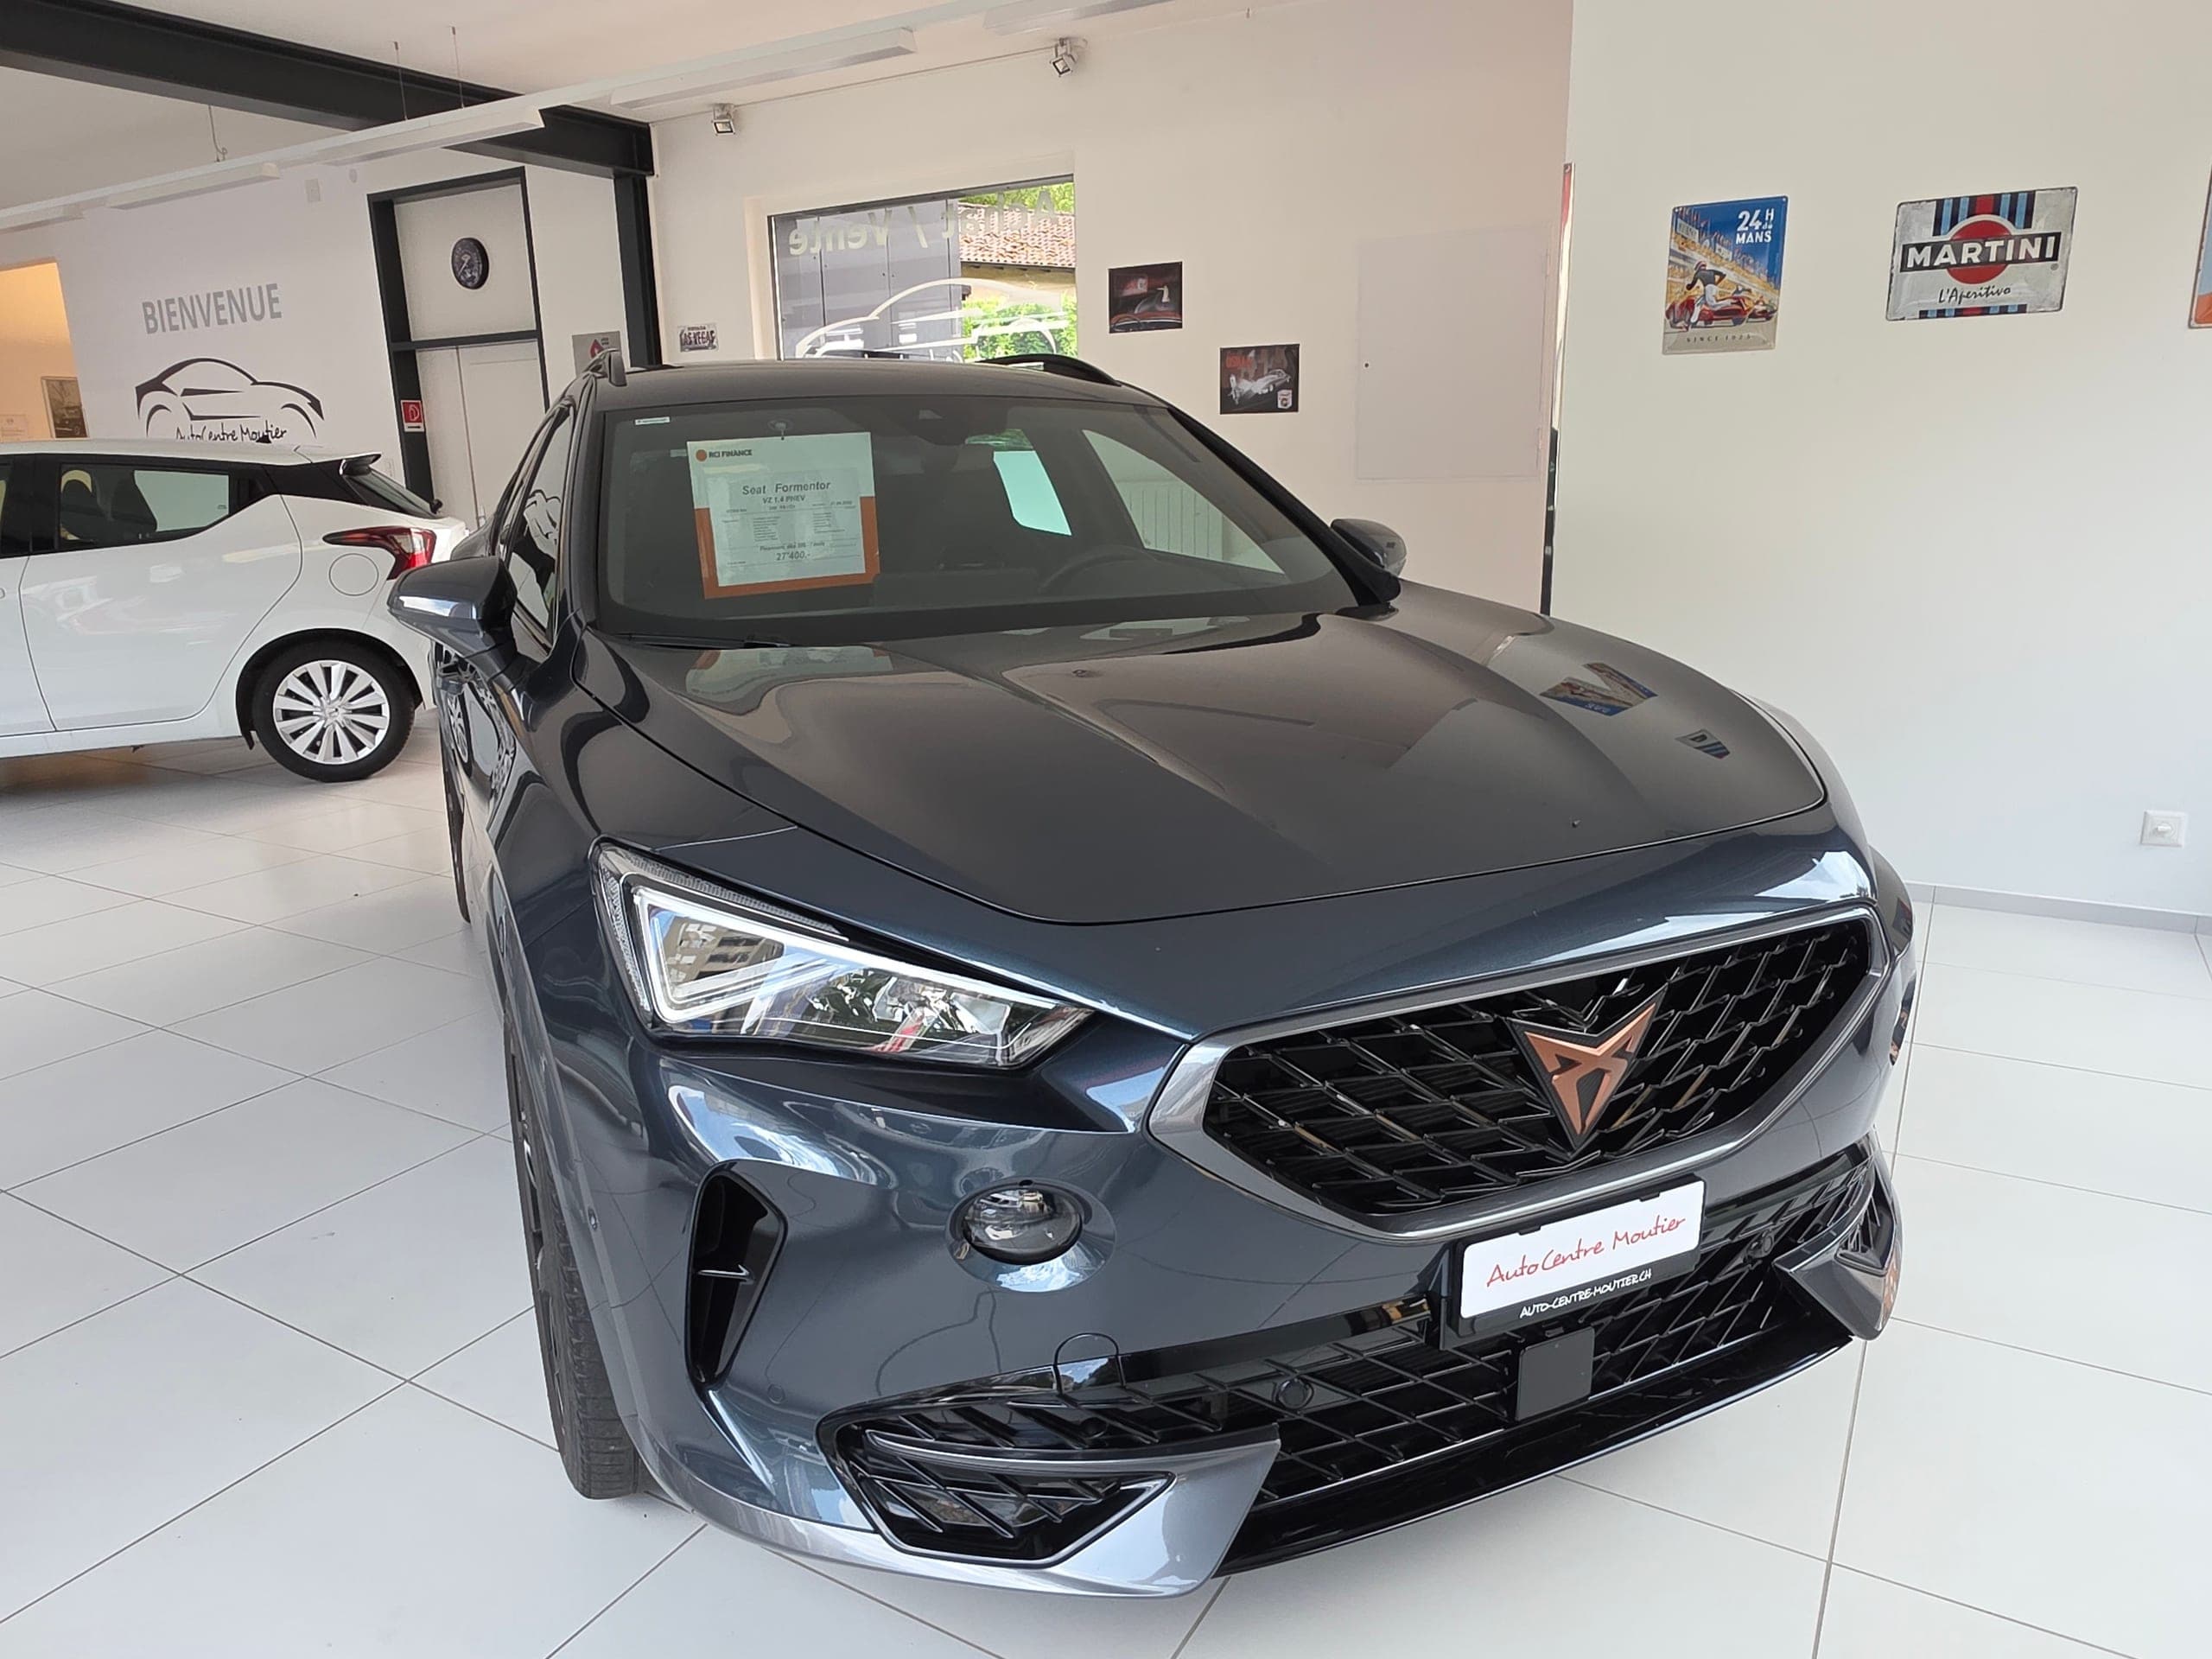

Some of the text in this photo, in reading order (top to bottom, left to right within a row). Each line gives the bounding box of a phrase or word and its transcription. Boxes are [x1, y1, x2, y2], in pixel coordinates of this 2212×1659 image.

[1737, 208, 1775, 232] 24 H
[1735, 231, 1772, 245] MANS
[1907, 236, 2056, 268] MARTINI
[1937, 284, 2012, 305] L'Aperitivo
[142, 283, 283, 335] BIENVENUE
[721, 448, 753, 458] FINANCE
[742, 480, 831, 495] Seat Formentor
[1612, 1214, 1687, 1250] Moutier
[1519, 1268, 1652, 1319] AUTO-CENTRE-MOUTIER.CH
